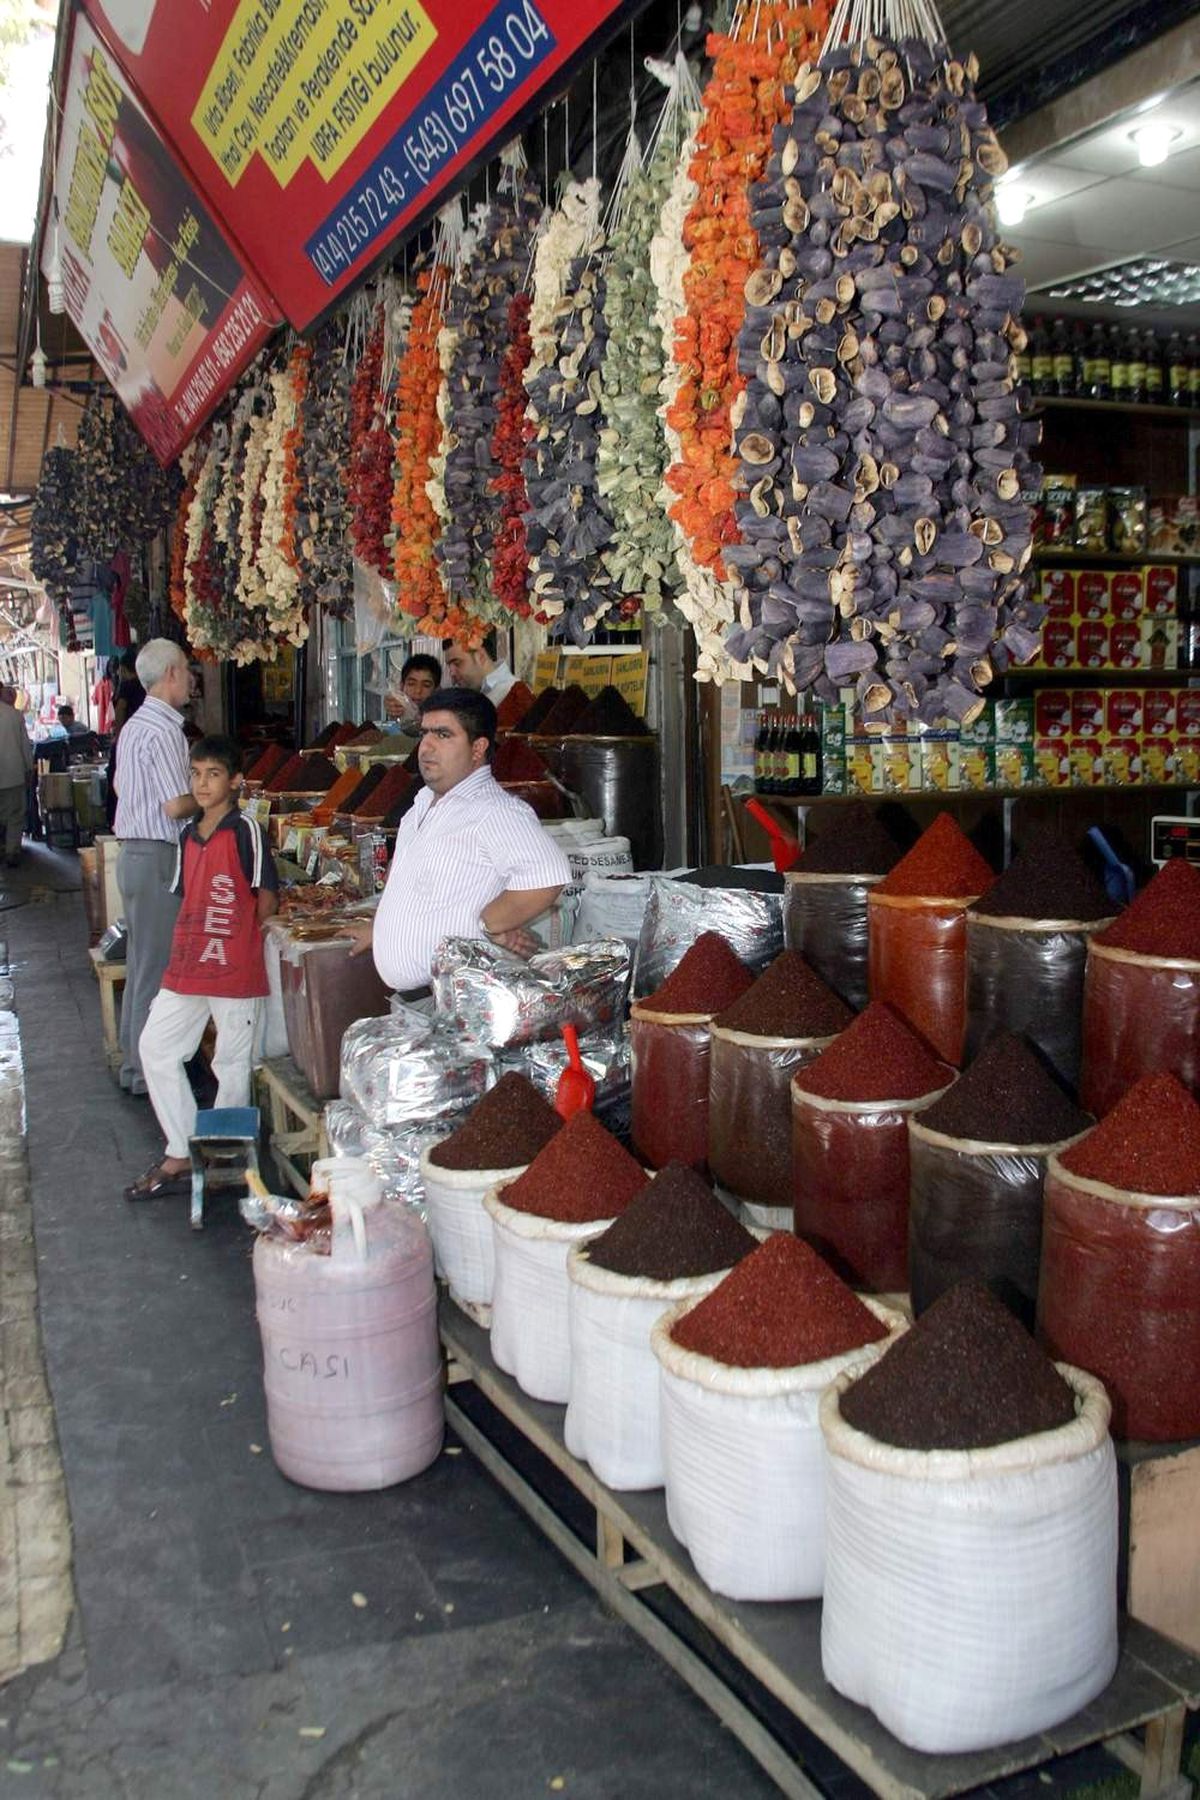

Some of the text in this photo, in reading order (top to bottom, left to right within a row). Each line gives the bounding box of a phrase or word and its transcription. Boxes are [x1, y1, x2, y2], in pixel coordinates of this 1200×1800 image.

[233, 11, 268, 74] Fabrika
[300, 17, 358, 108] Perakende
[292, 98, 309, 123] ve
[310, 118, 342, 162] URFA
[363, 9, 421, 87] bulunur.
[264, 115, 299, 165] Toptan
[312, 232, 352, 287] (414)
[336, 206, 369, 252] 215
[358, 187, 388, 228] 72
[379, 165, 405, 204] 43
[403, 111, 458, 186] (543)
[445, 67, 484, 133] 697
[476, 36, 516, 92] 58
[506, 0, 549, 59] 04
